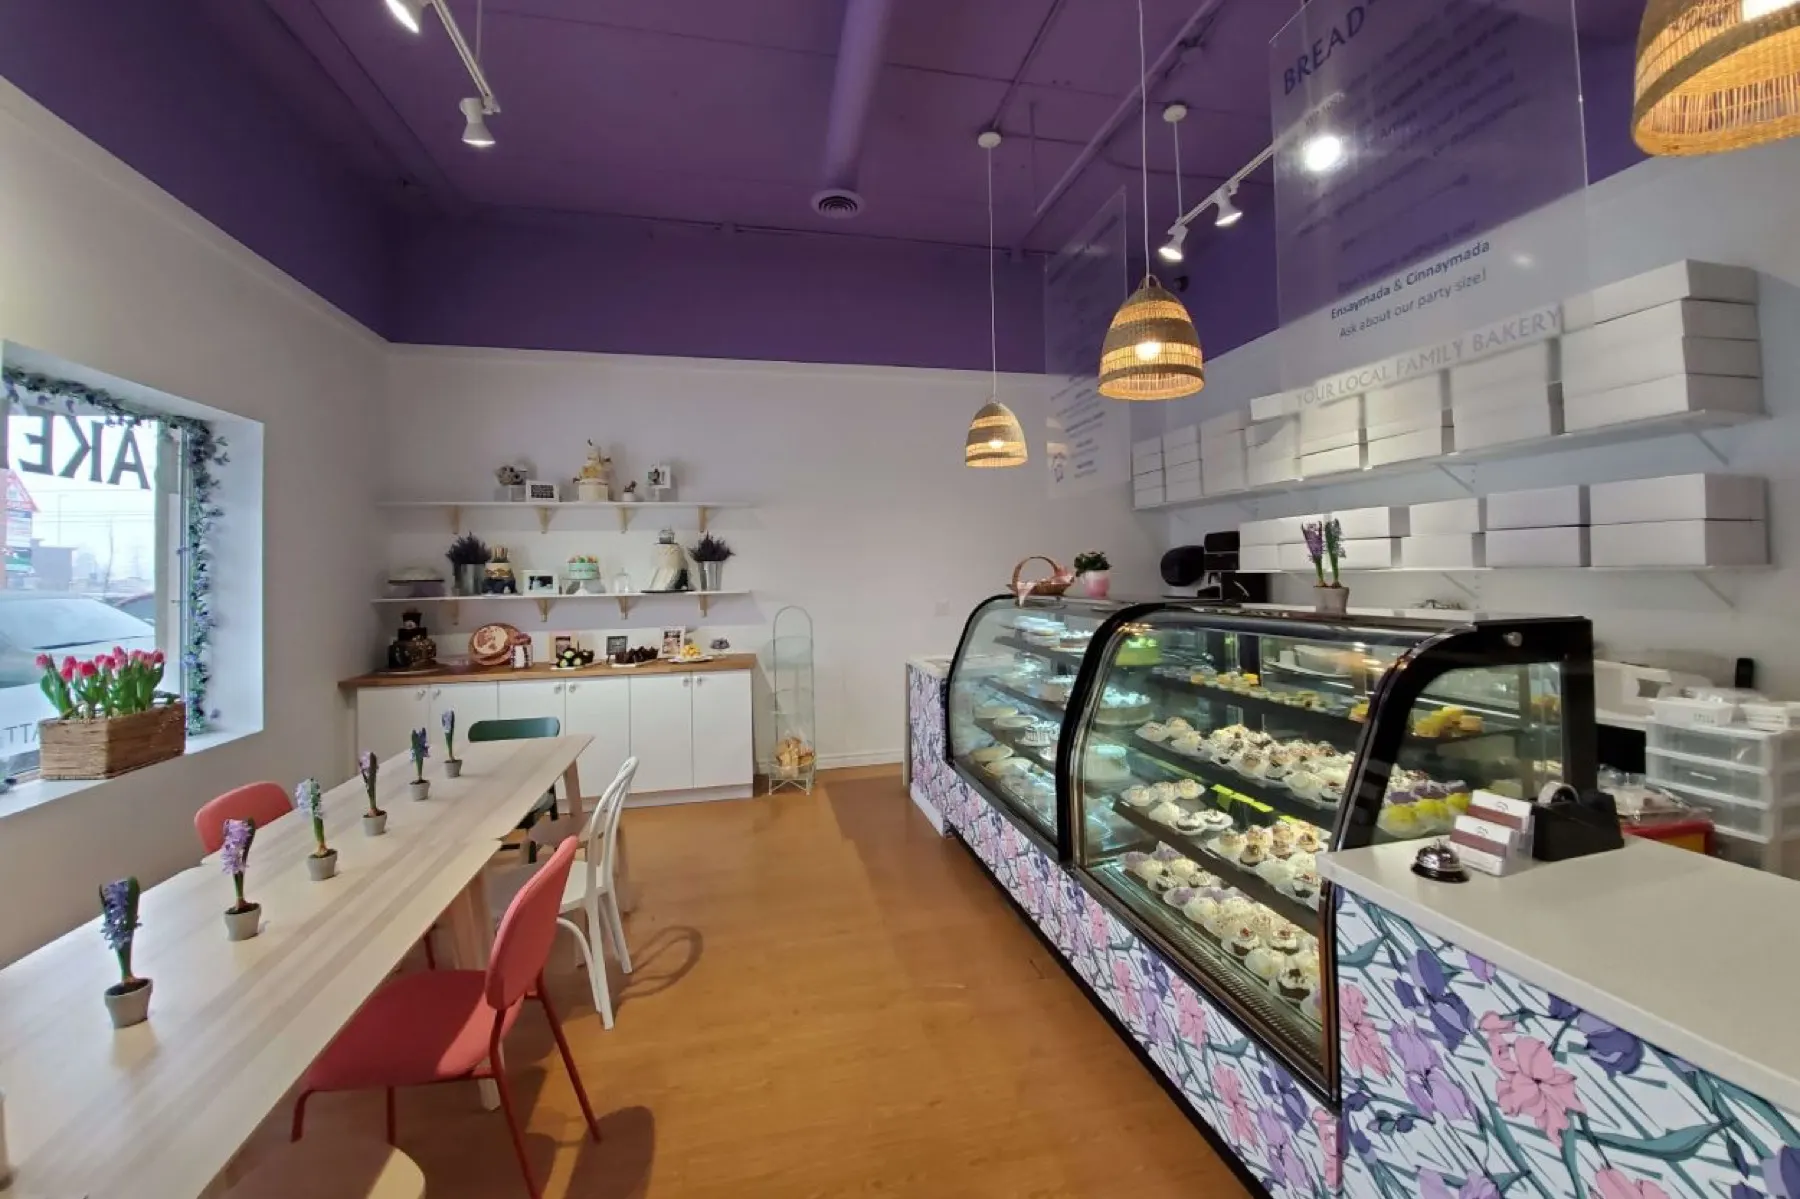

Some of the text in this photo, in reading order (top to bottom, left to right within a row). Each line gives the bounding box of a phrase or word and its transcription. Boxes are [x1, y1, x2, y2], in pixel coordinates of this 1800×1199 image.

[1283, 0, 1378, 96] BREAD
[1331, 286, 1391, 319] Ensaymada
[1394, 277, 1402, 291] &
[1406, 241, 1490, 286] Cinnaymada
[1339, 267, 1487, 338] Ask about our party size!
[1297, 308, 1561, 406] YOUR LOCAL FAMILY BAKERY
